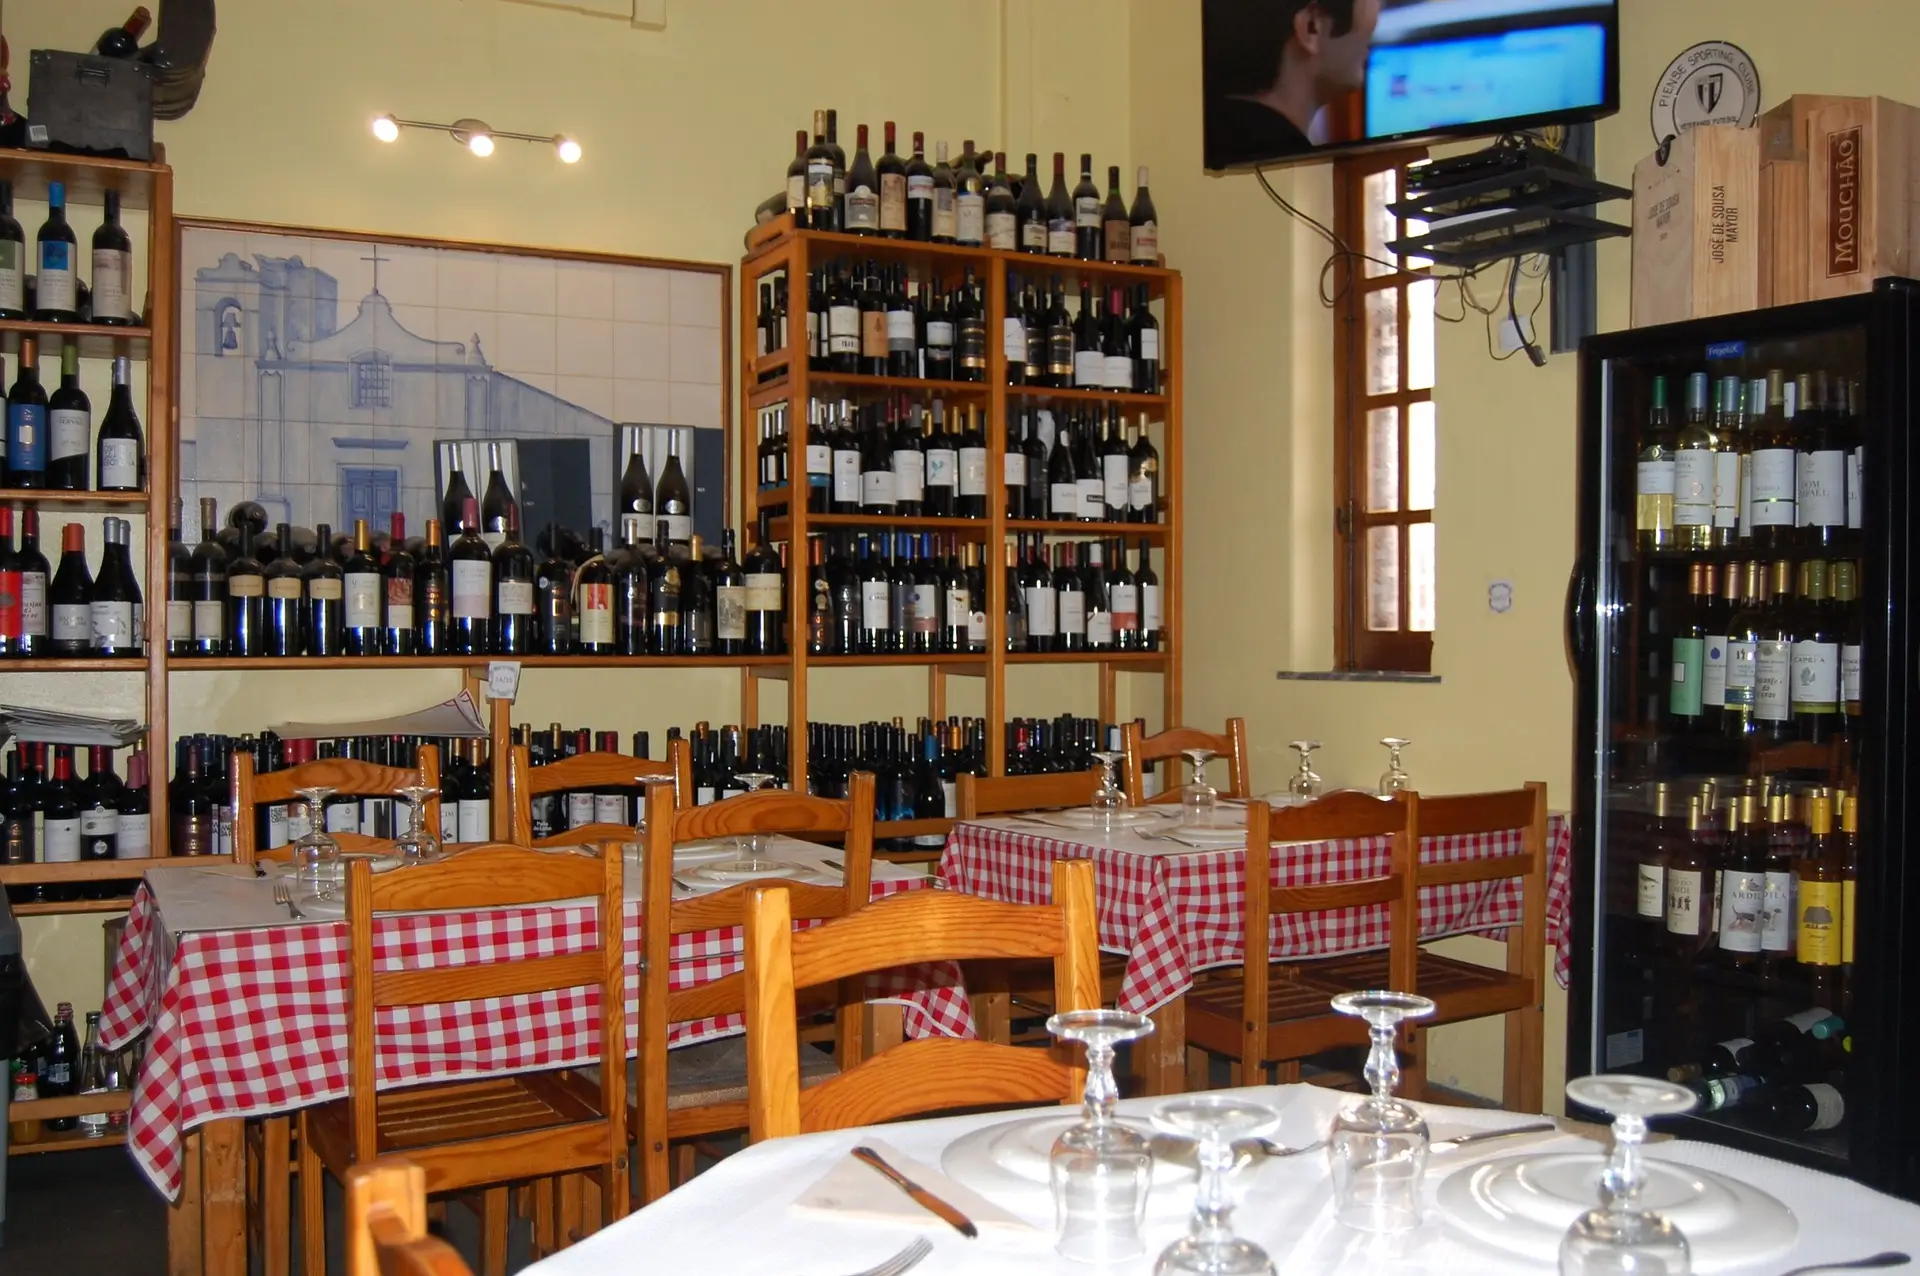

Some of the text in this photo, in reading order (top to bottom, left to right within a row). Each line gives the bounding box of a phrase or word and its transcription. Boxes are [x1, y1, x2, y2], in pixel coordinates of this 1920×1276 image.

[1659, 63, 1687, 107] PIENSE
[1687, 48, 1735, 66] SPORTING
[1711, 184, 1725, 219] SOUSA
[1834, 139, 1854, 265] MOUCHÃO
[1711, 221, 1724, 235] DE
[1725, 206, 1739, 243] MAYOR
